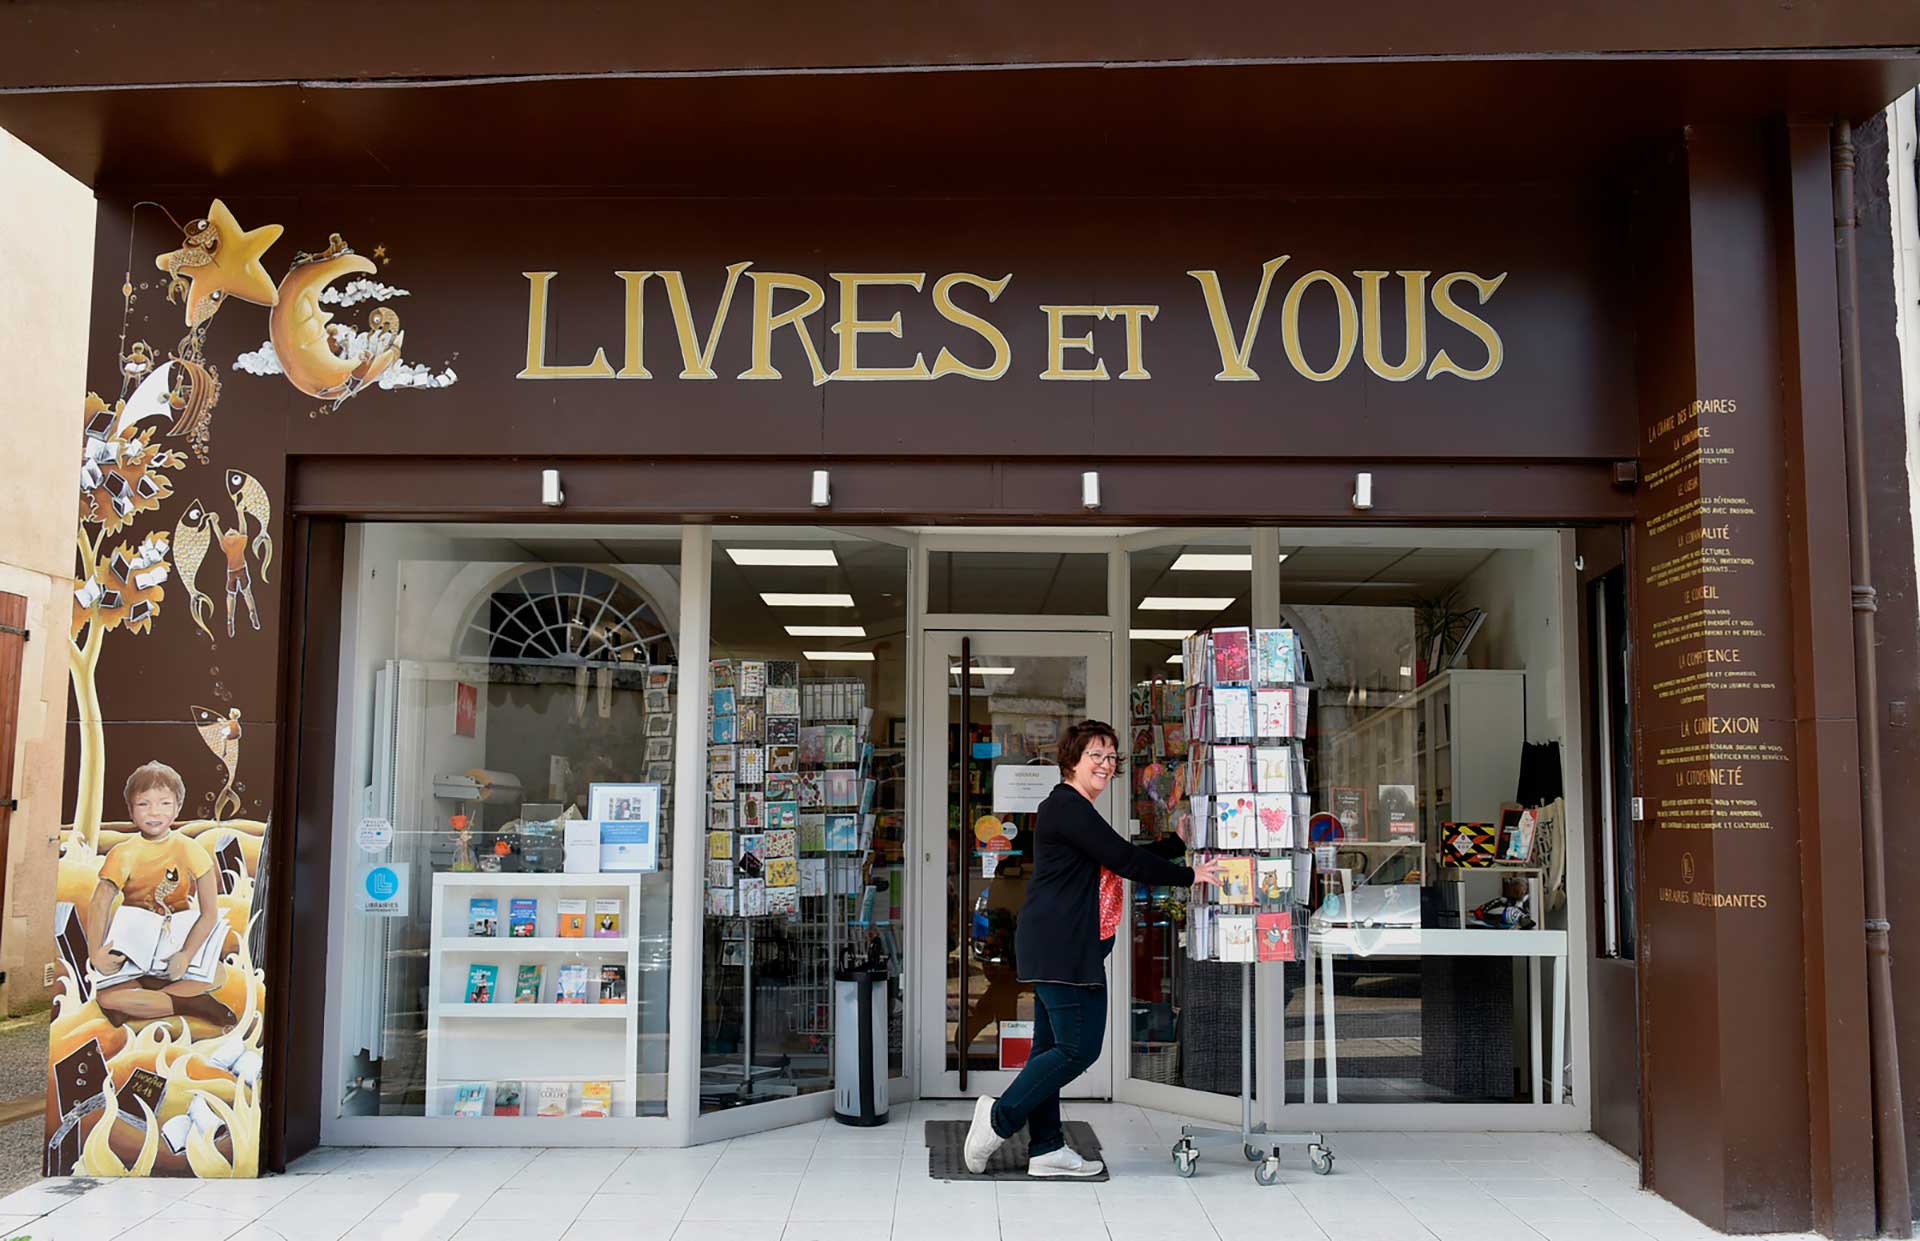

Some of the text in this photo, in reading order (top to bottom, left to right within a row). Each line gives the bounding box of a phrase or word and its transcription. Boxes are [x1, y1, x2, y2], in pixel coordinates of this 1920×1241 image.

[515, 254, 1508, 386] LIVRES ET VOUS
